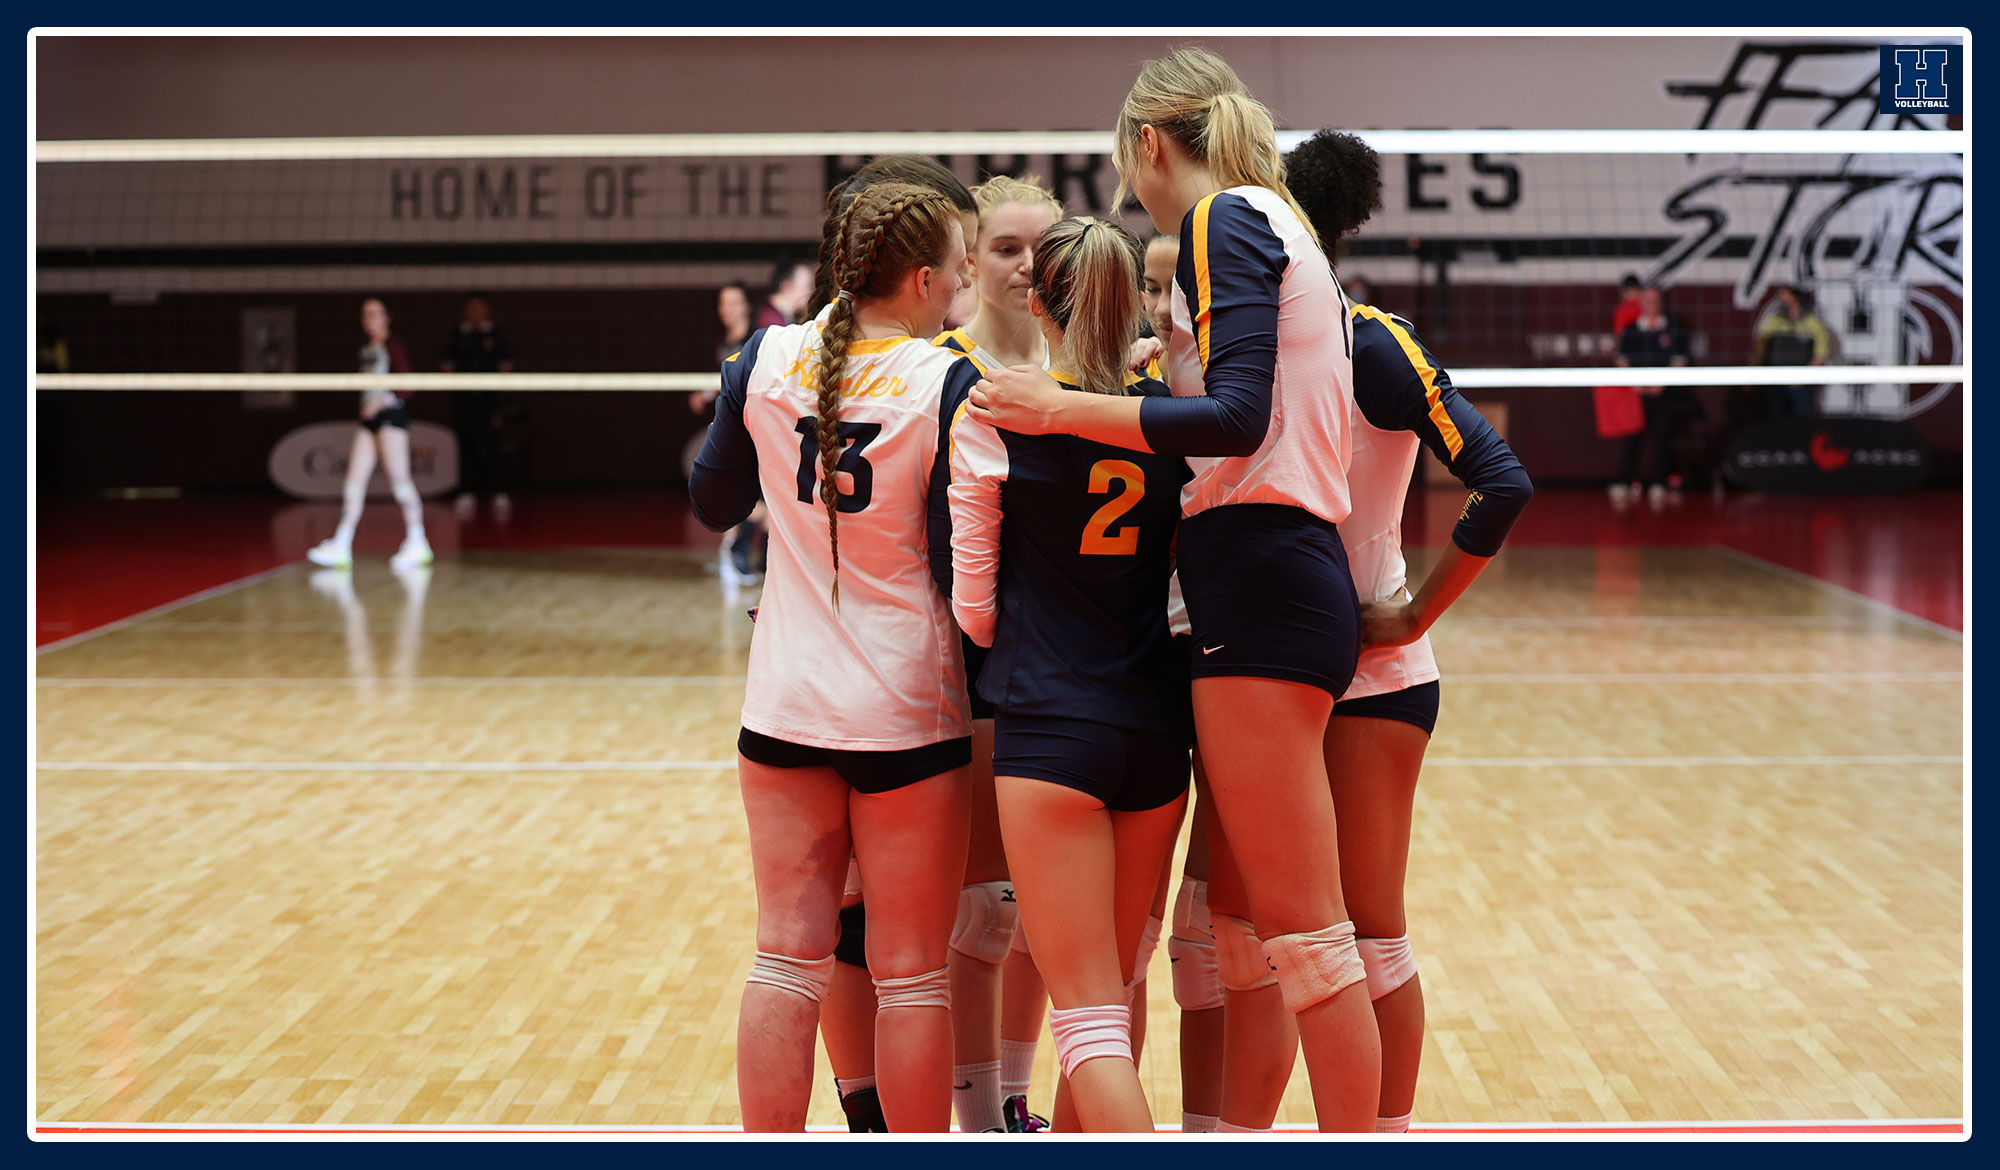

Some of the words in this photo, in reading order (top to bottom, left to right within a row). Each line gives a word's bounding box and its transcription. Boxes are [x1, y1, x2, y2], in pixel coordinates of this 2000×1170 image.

[391, 166, 556, 220] HOME
[584, 165, 649, 219] OF
[681, 163, 790, 218] THE
[795, 416, 882, 513] 13
[1079, 459, 1145, 555] 2
